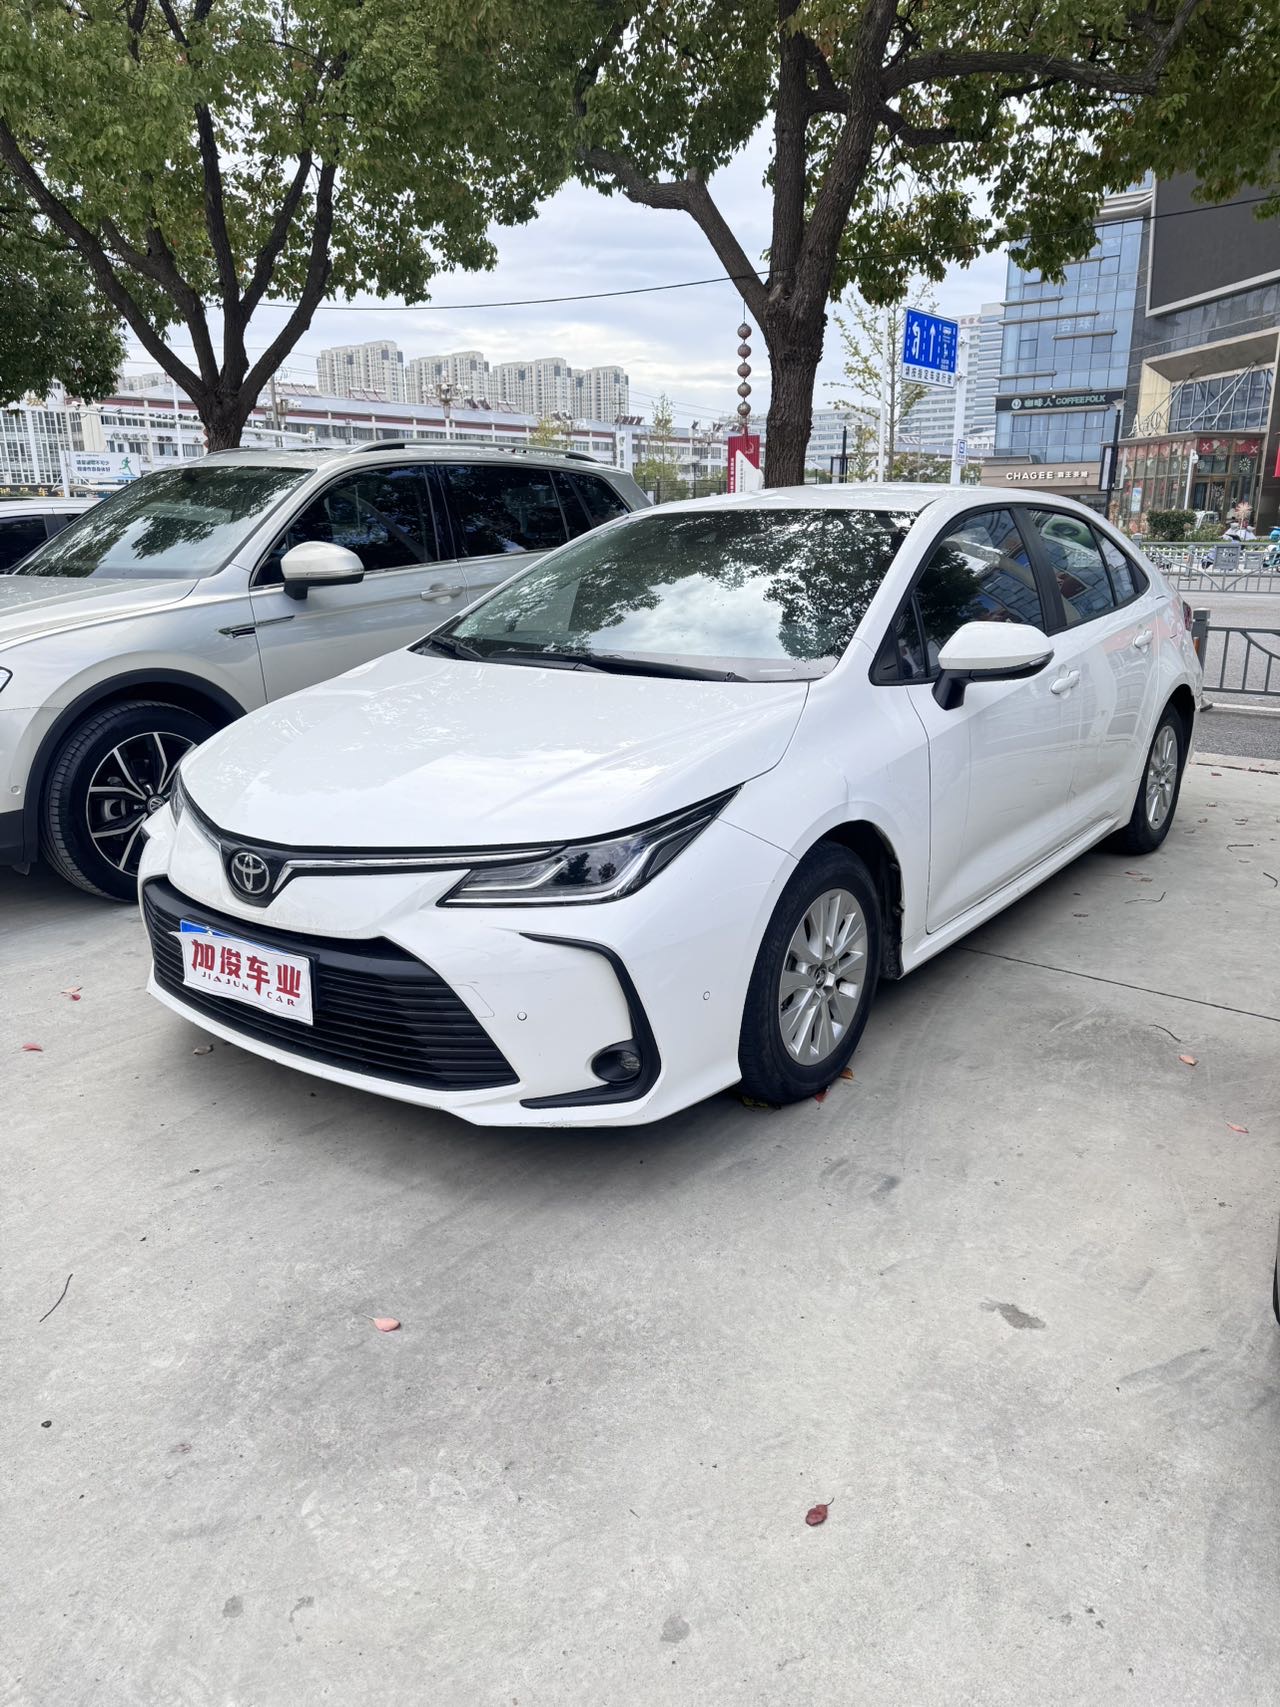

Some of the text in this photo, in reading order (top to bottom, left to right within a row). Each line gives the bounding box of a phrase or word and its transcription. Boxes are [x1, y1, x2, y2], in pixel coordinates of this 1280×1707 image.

[1024, 398, 1053, 408] 咖啡人
[1006, 471, 1054, 480] CHAGEE
[191, 939, 302, 999] 加俊车业
[201, 970, 296, 1007] JIAJUN CAR
